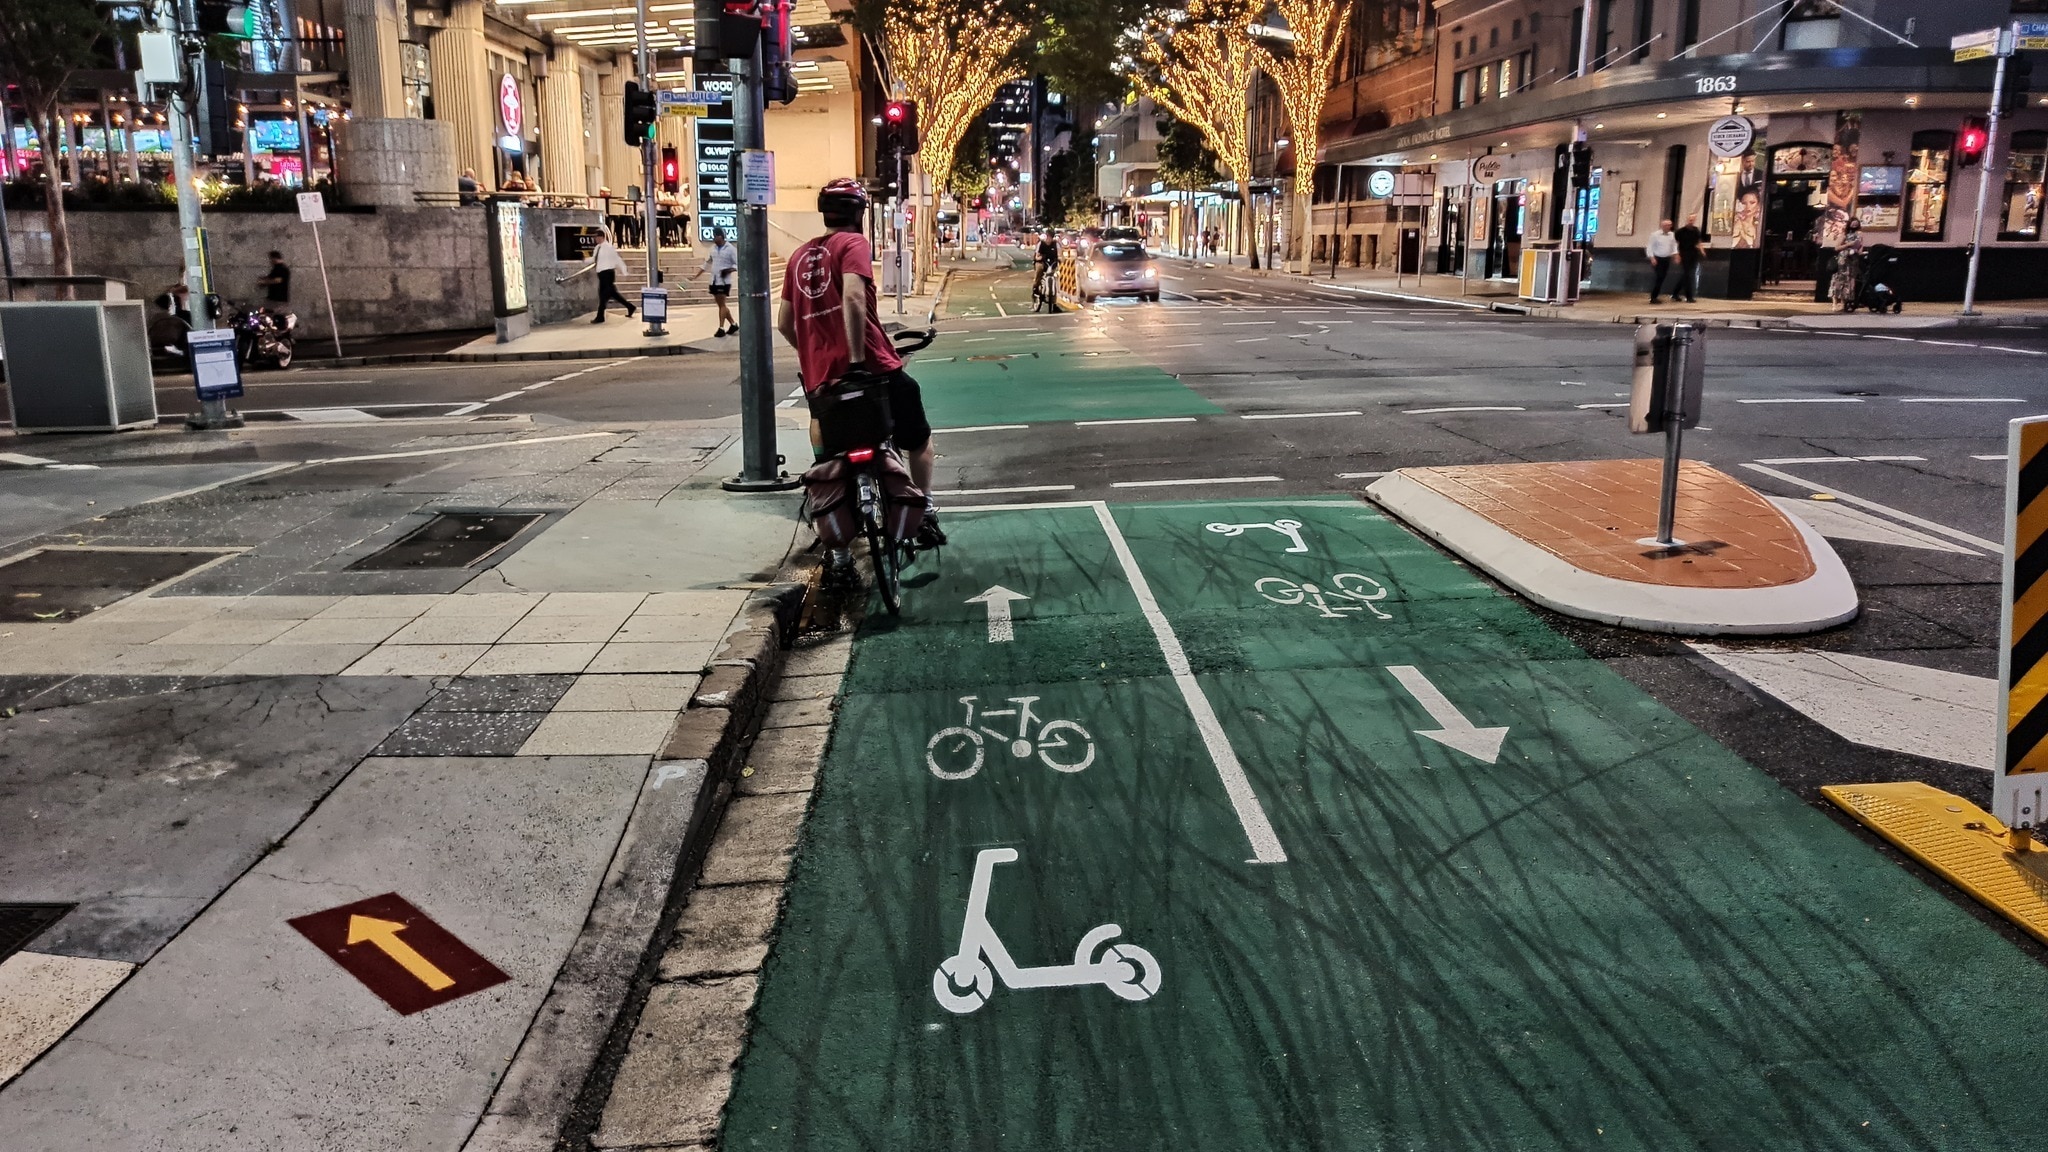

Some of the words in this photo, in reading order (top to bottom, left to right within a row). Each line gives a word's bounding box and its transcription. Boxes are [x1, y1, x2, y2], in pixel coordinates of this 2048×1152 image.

[1695, 75, 1737, 93] 1863
[672, 92, 710, 100] CHARLOTTE
[1479, 161, 1501, 171] Public
